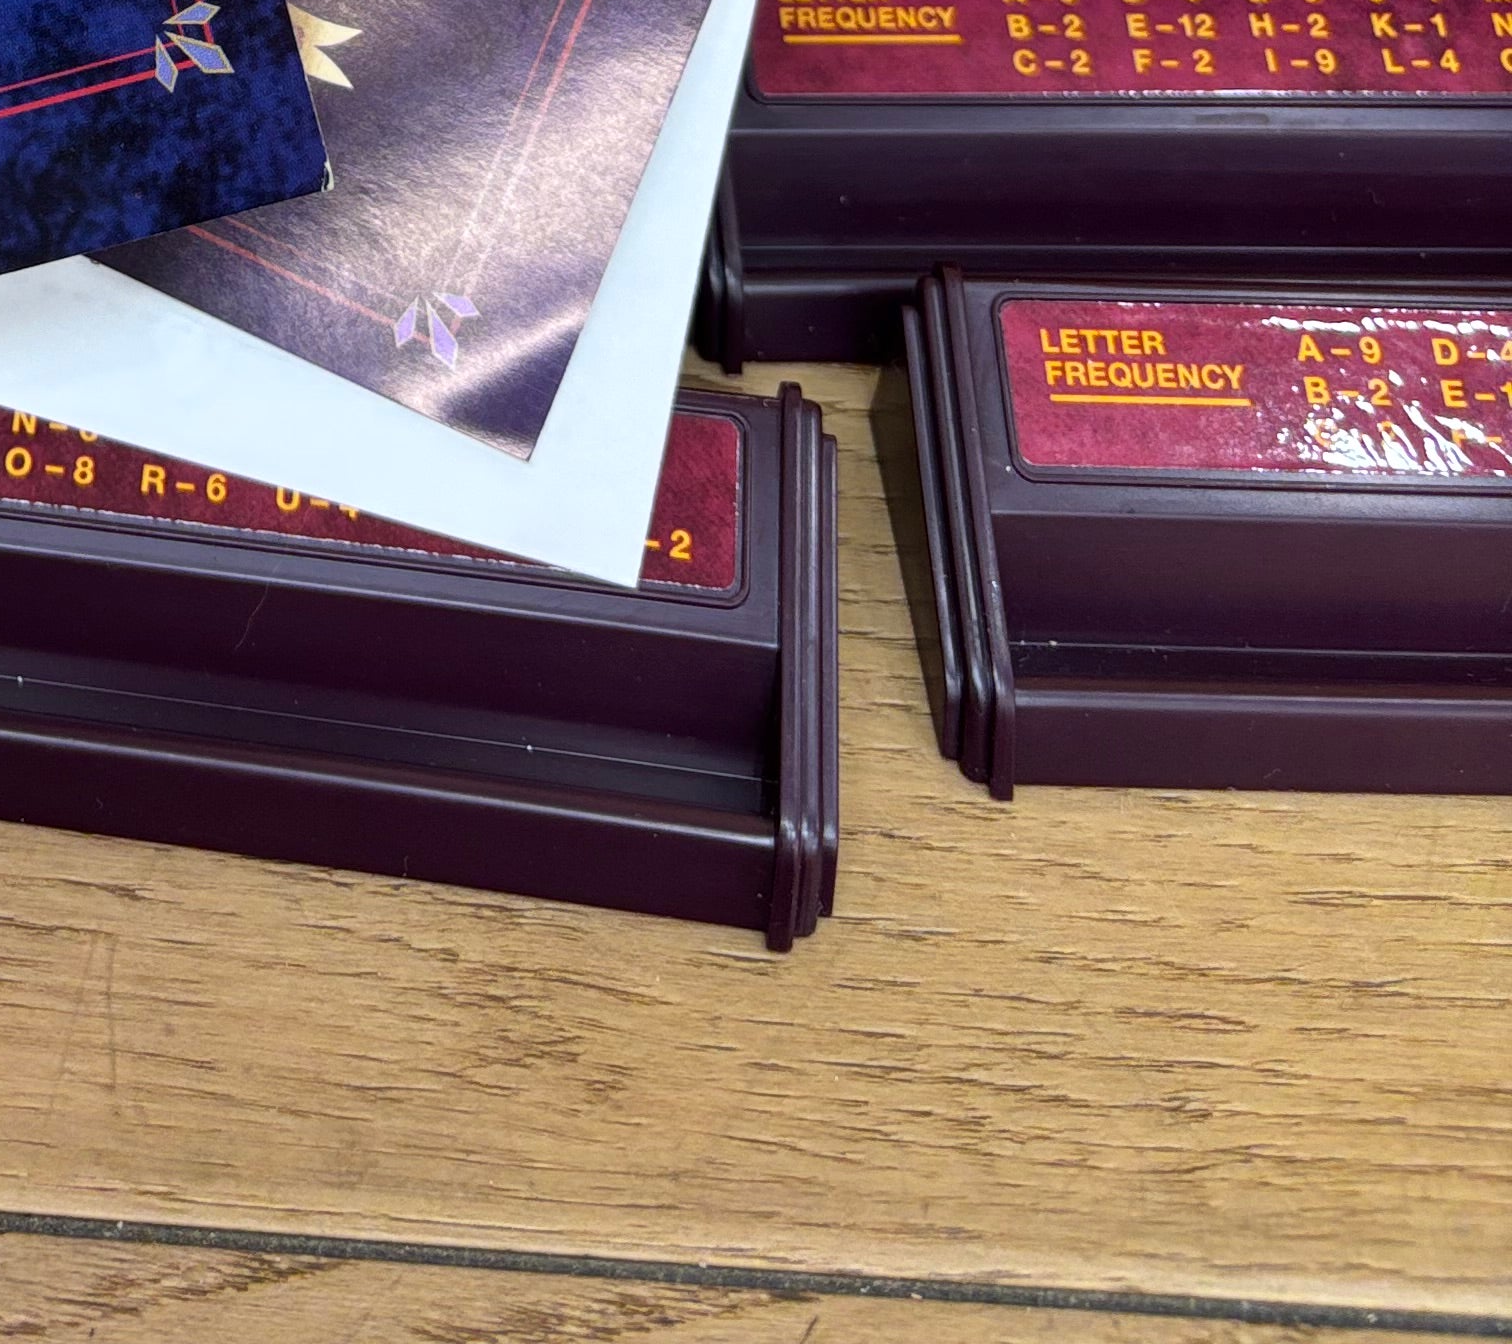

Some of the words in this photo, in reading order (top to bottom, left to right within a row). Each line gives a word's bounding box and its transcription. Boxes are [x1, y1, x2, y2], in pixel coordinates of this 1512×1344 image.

[778, 6, 956, 31] FREQUENCY
[1040, 328, 1168, 355] LETTER
[1044, 360, 1245, 390] FREQUENCY
